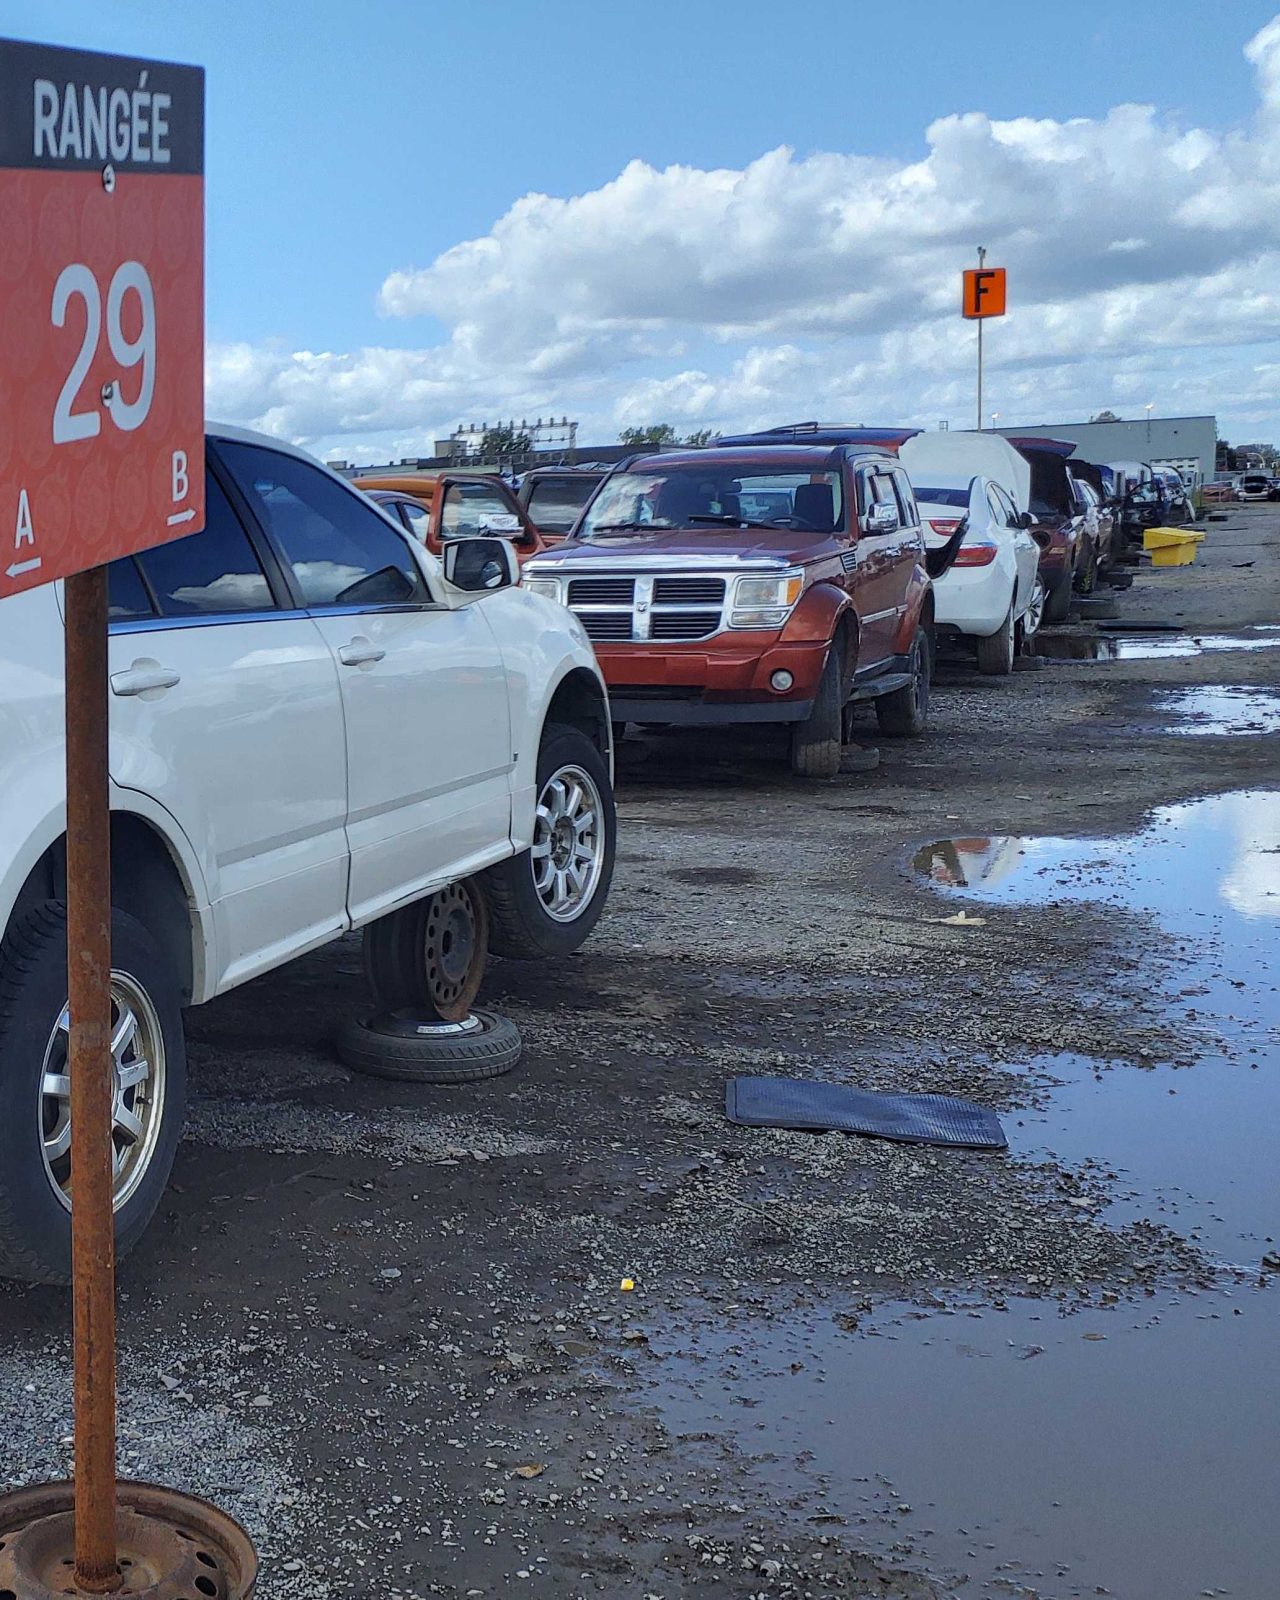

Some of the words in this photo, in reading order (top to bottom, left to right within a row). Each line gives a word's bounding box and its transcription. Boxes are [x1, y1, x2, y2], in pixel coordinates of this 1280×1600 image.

[33, 70, 171, 163] RANGÉE
[974, 271, 995, 313] F
[51, 260, 156, 444] 29
[172, 450, 189, 502] B
[15, 489, 35, 549] A
